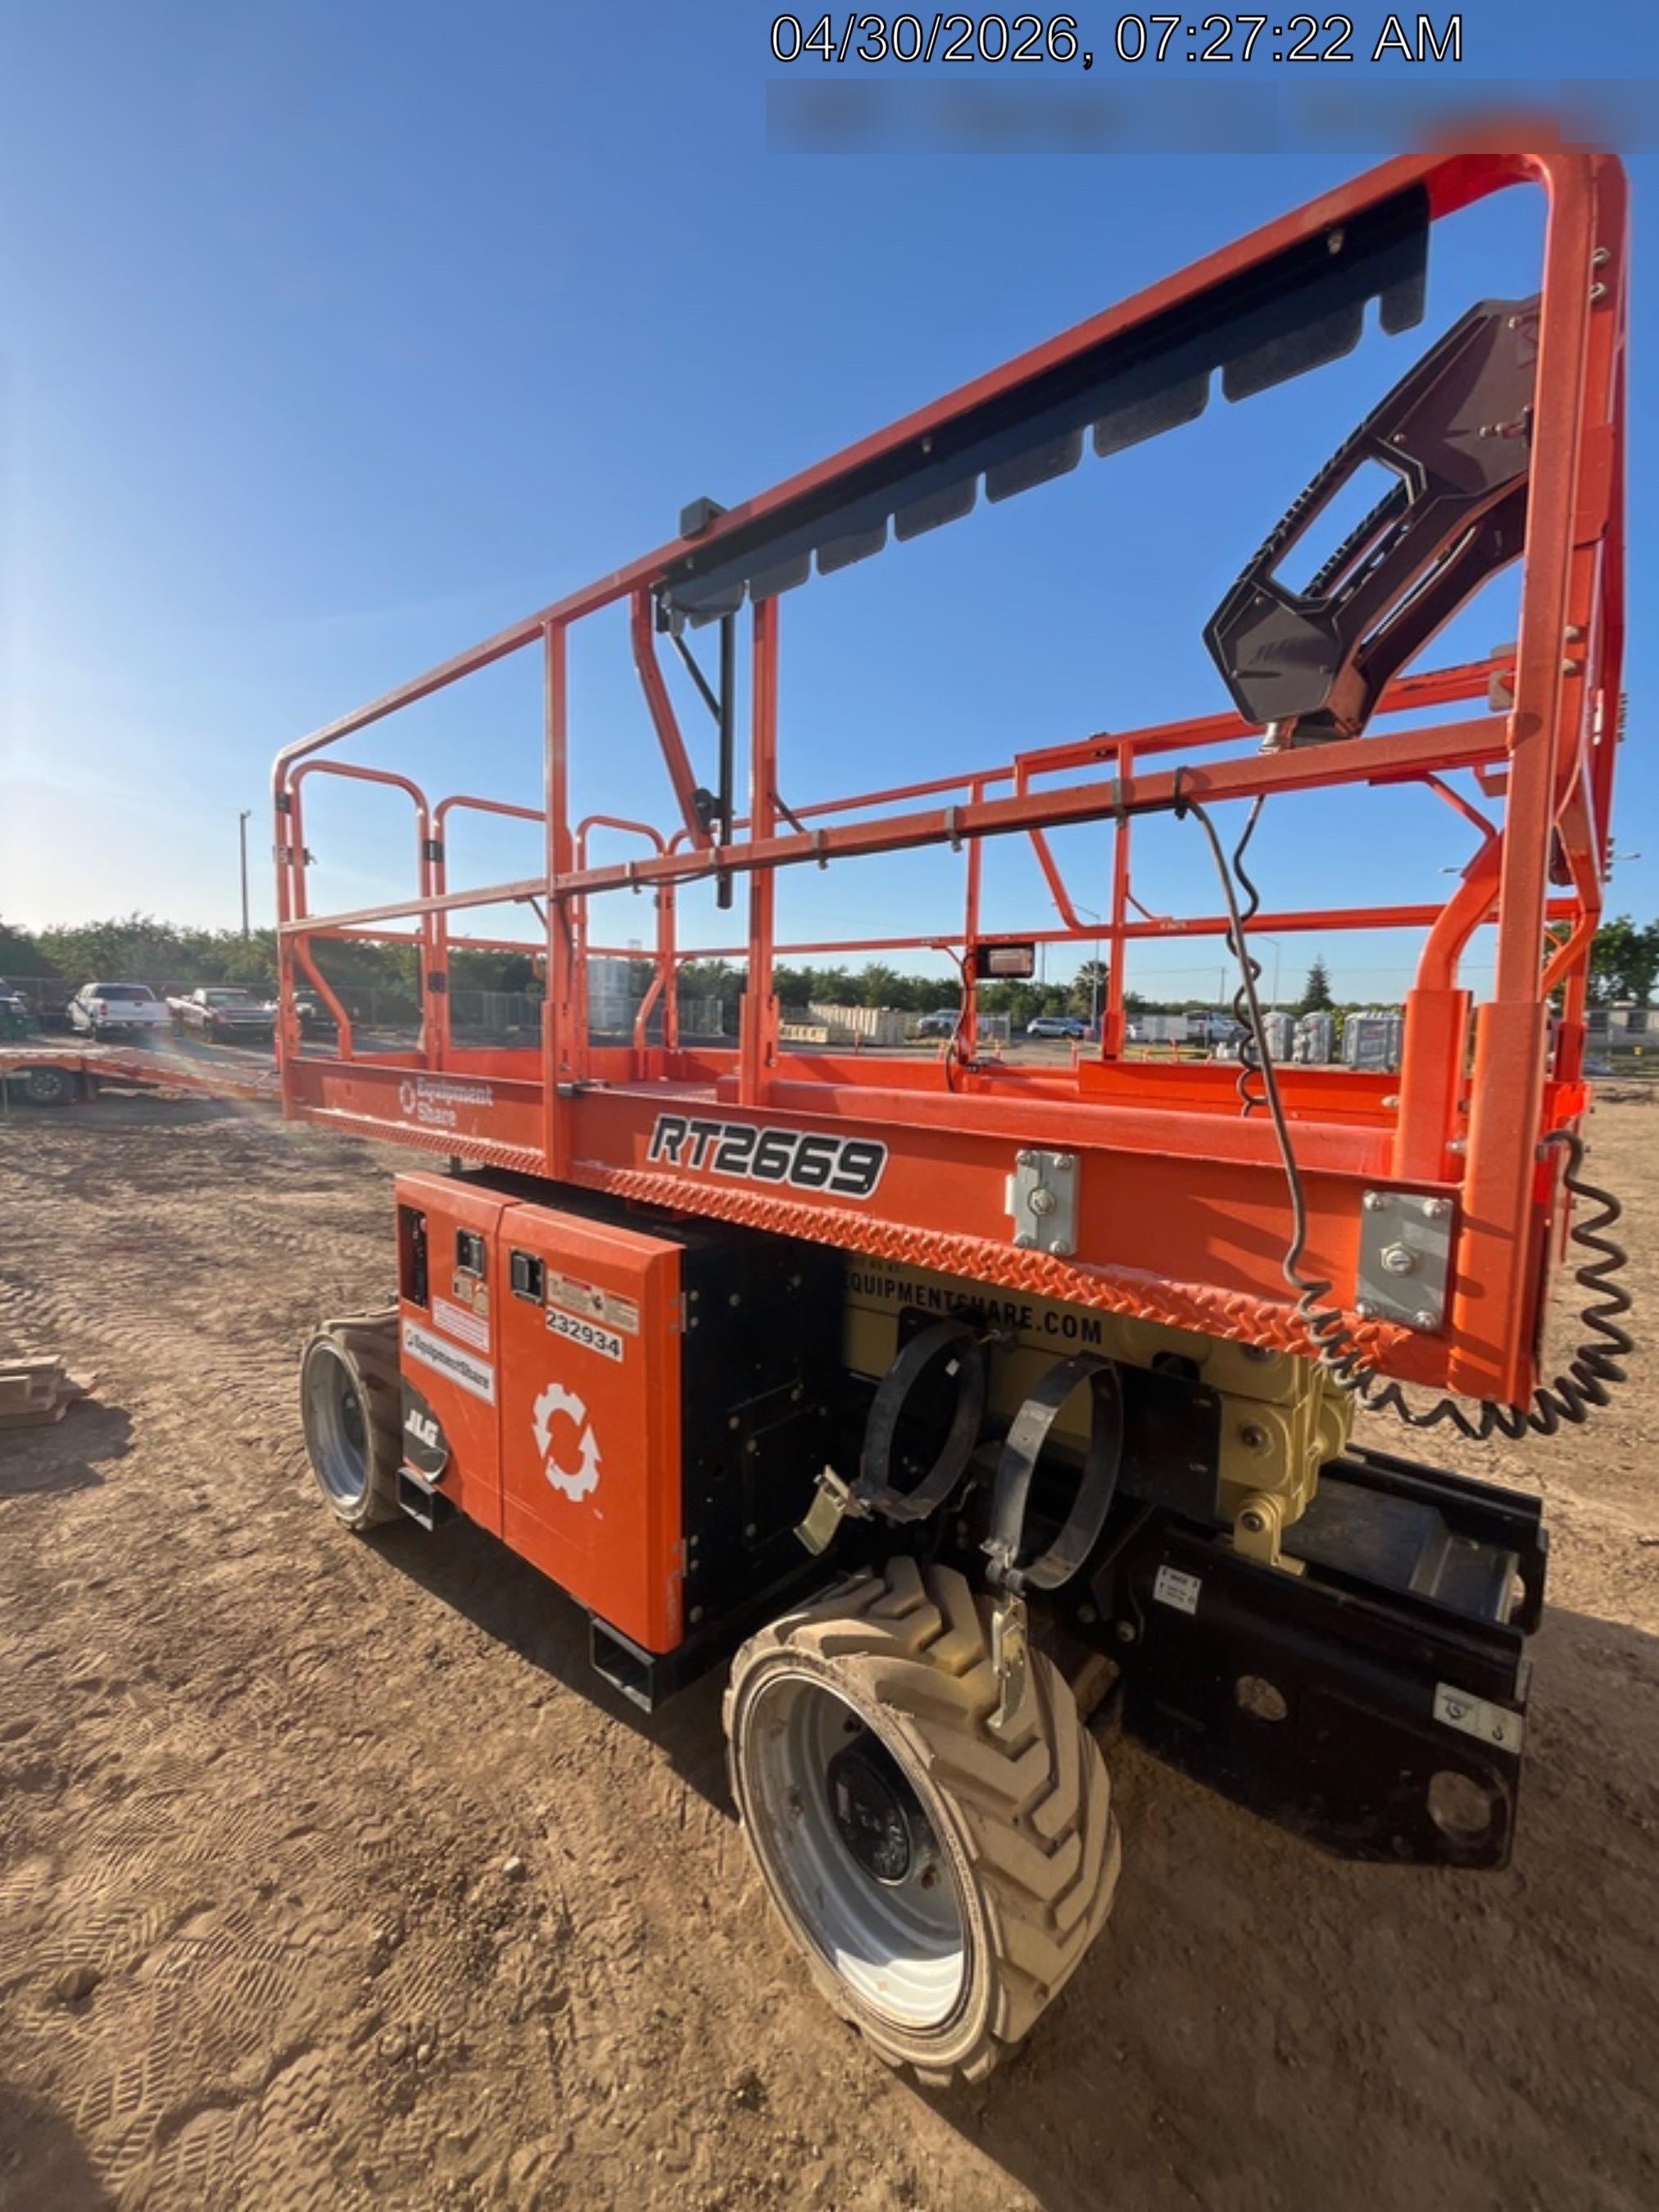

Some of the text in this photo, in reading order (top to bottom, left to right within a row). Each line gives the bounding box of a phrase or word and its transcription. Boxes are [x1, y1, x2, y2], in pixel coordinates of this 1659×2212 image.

[648, 1114, 887, 1199] RT2669
[546, 1311, 620, 1357] 232934
[405, 1408, 439, 1448] JLG
